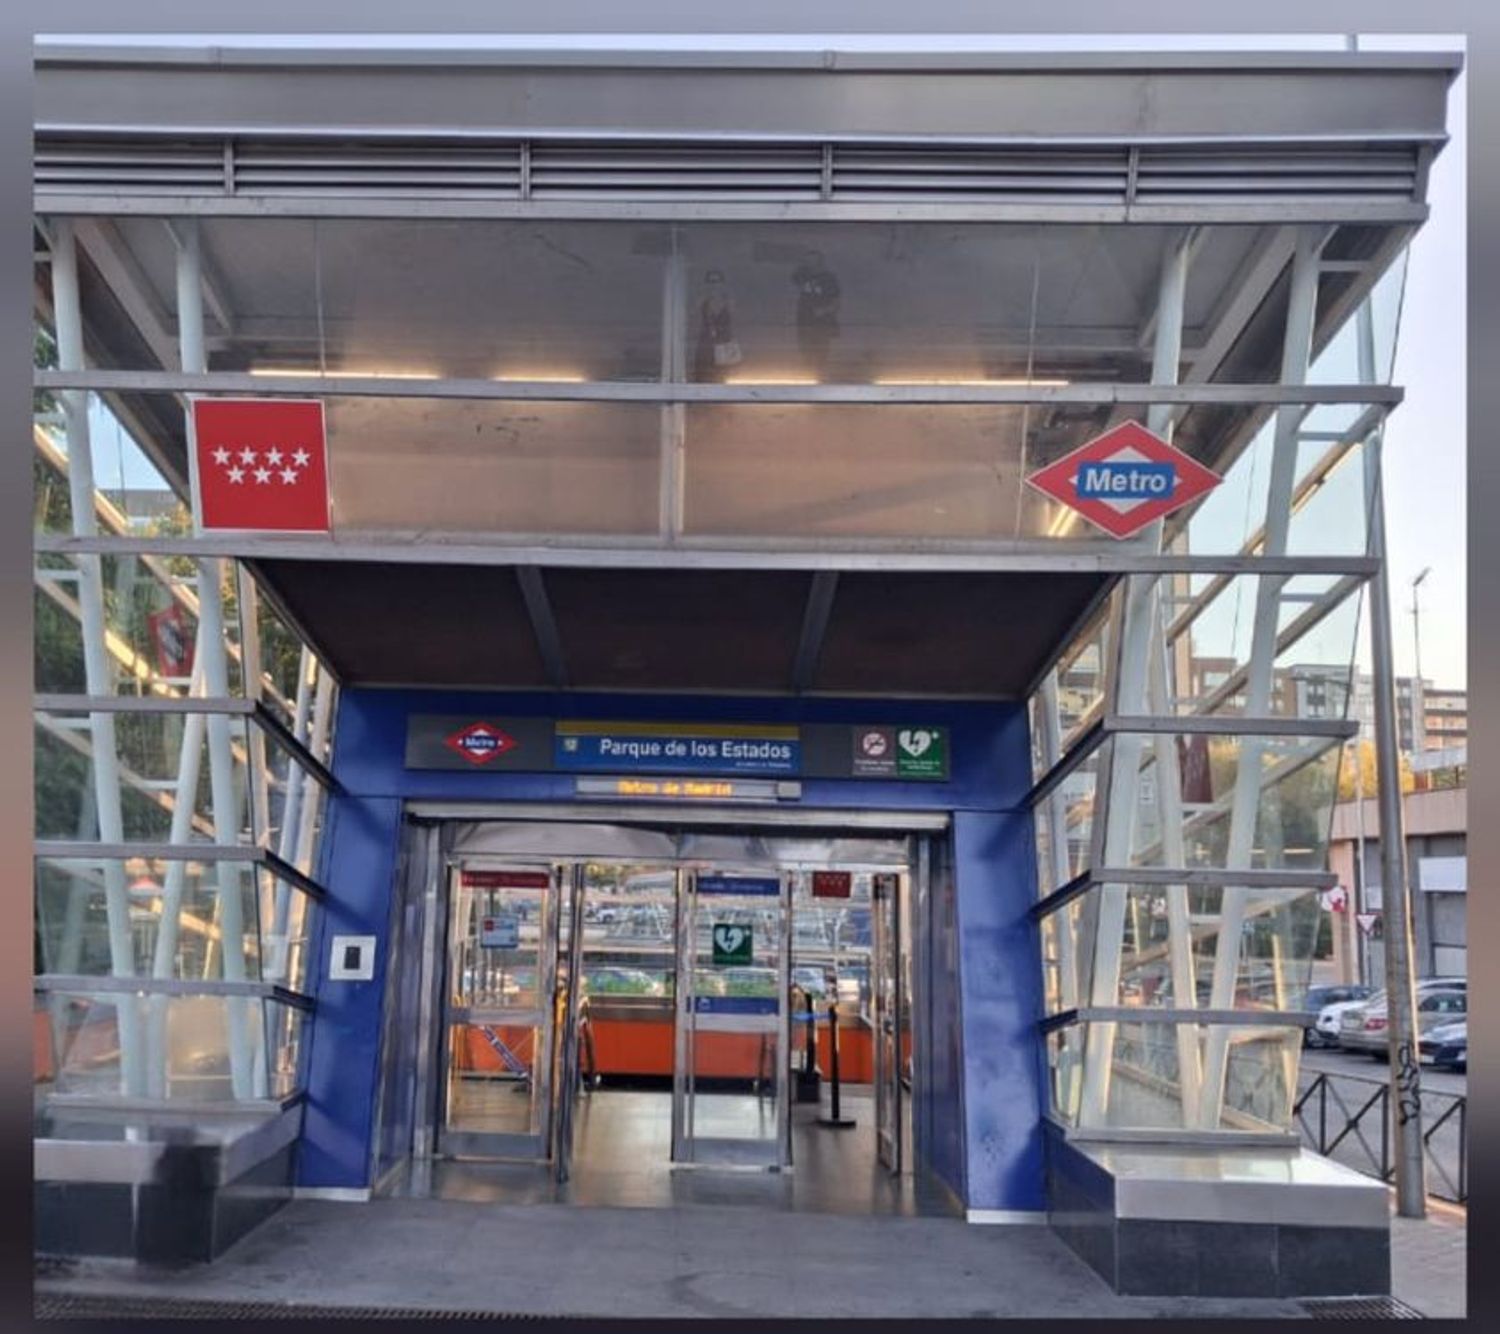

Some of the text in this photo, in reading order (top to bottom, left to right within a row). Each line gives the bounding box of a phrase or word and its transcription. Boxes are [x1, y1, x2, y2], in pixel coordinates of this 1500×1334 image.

[1084, 468, 1167, 492] Metro
[600, 738, 792, 759] Parque de los Estados
